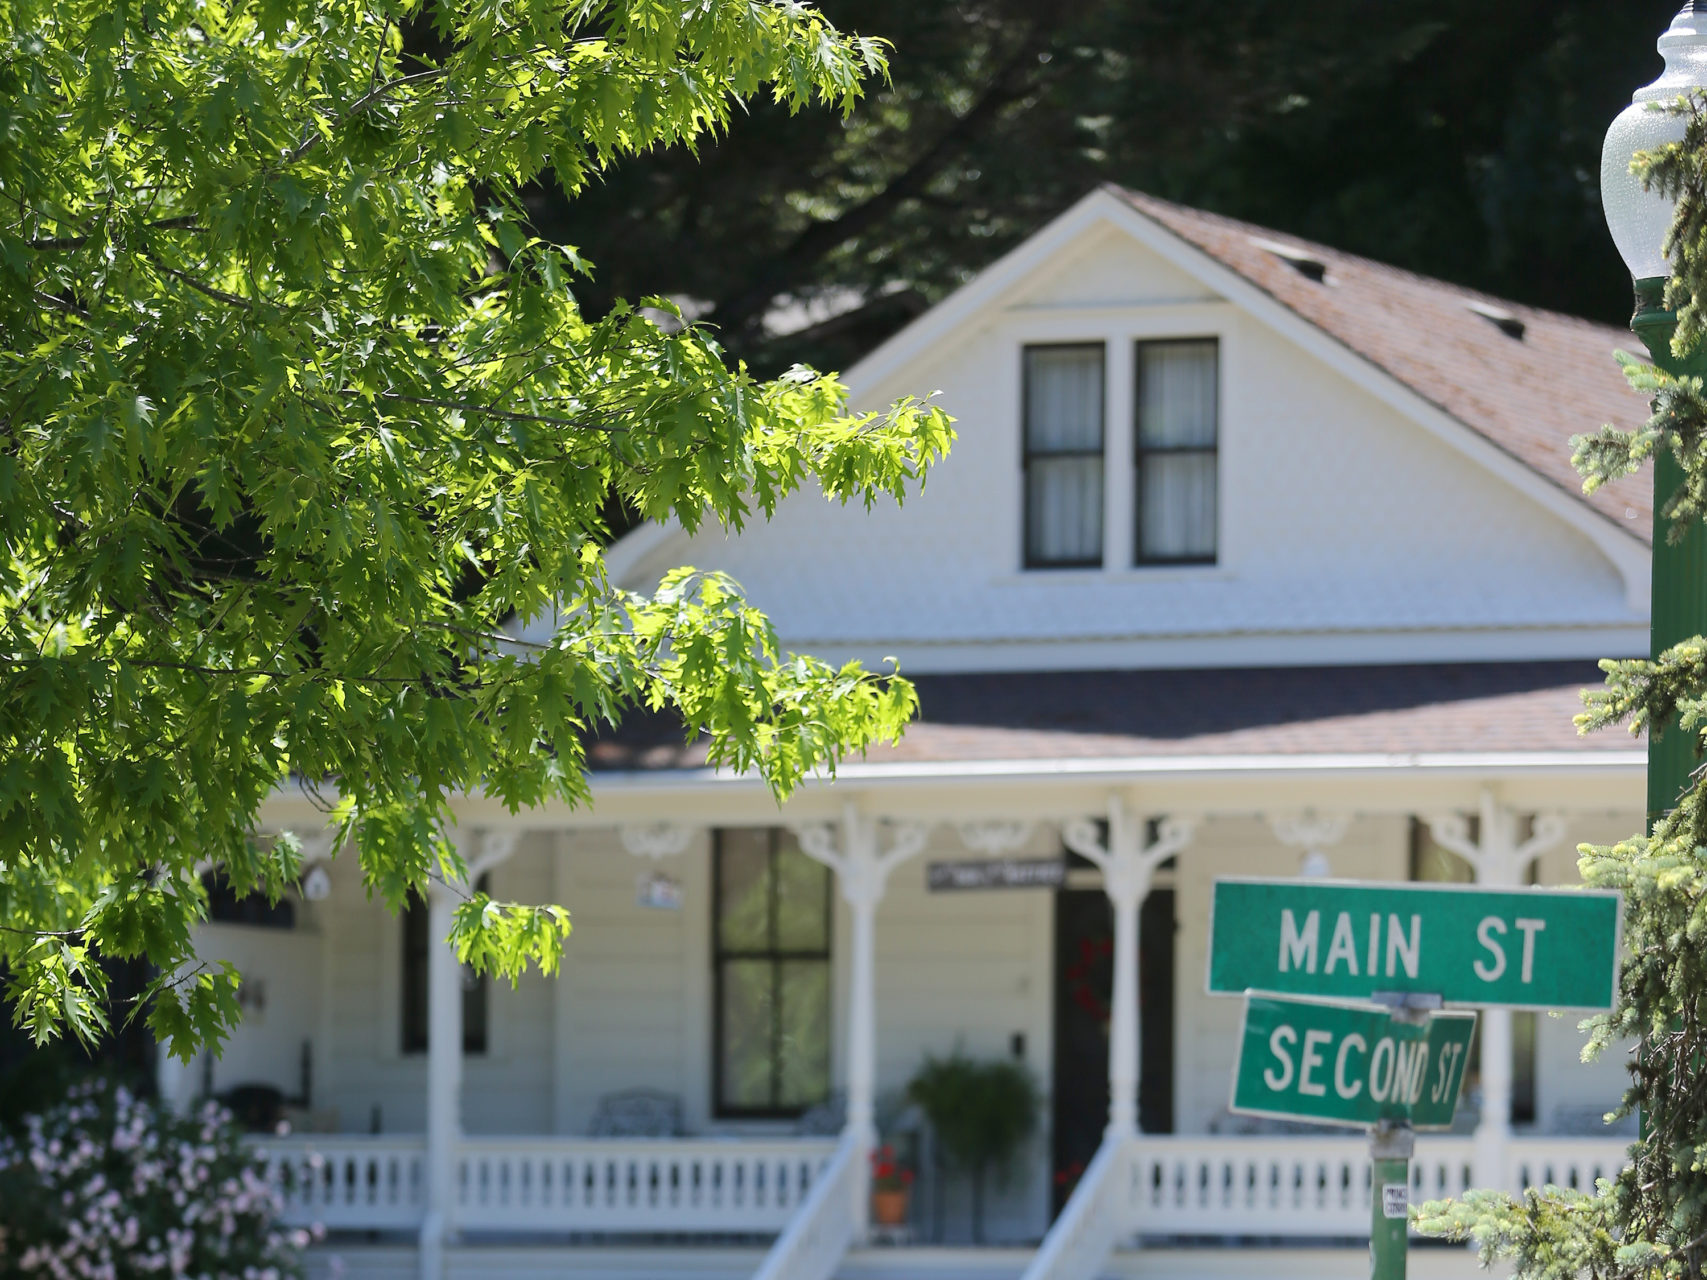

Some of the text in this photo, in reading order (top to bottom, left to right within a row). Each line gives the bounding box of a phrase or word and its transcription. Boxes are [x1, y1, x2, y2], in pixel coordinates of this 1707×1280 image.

[1278, 908, 1546, 984] MAIN ST
[1263, 1024, 1462, 1105] SECOND ST
